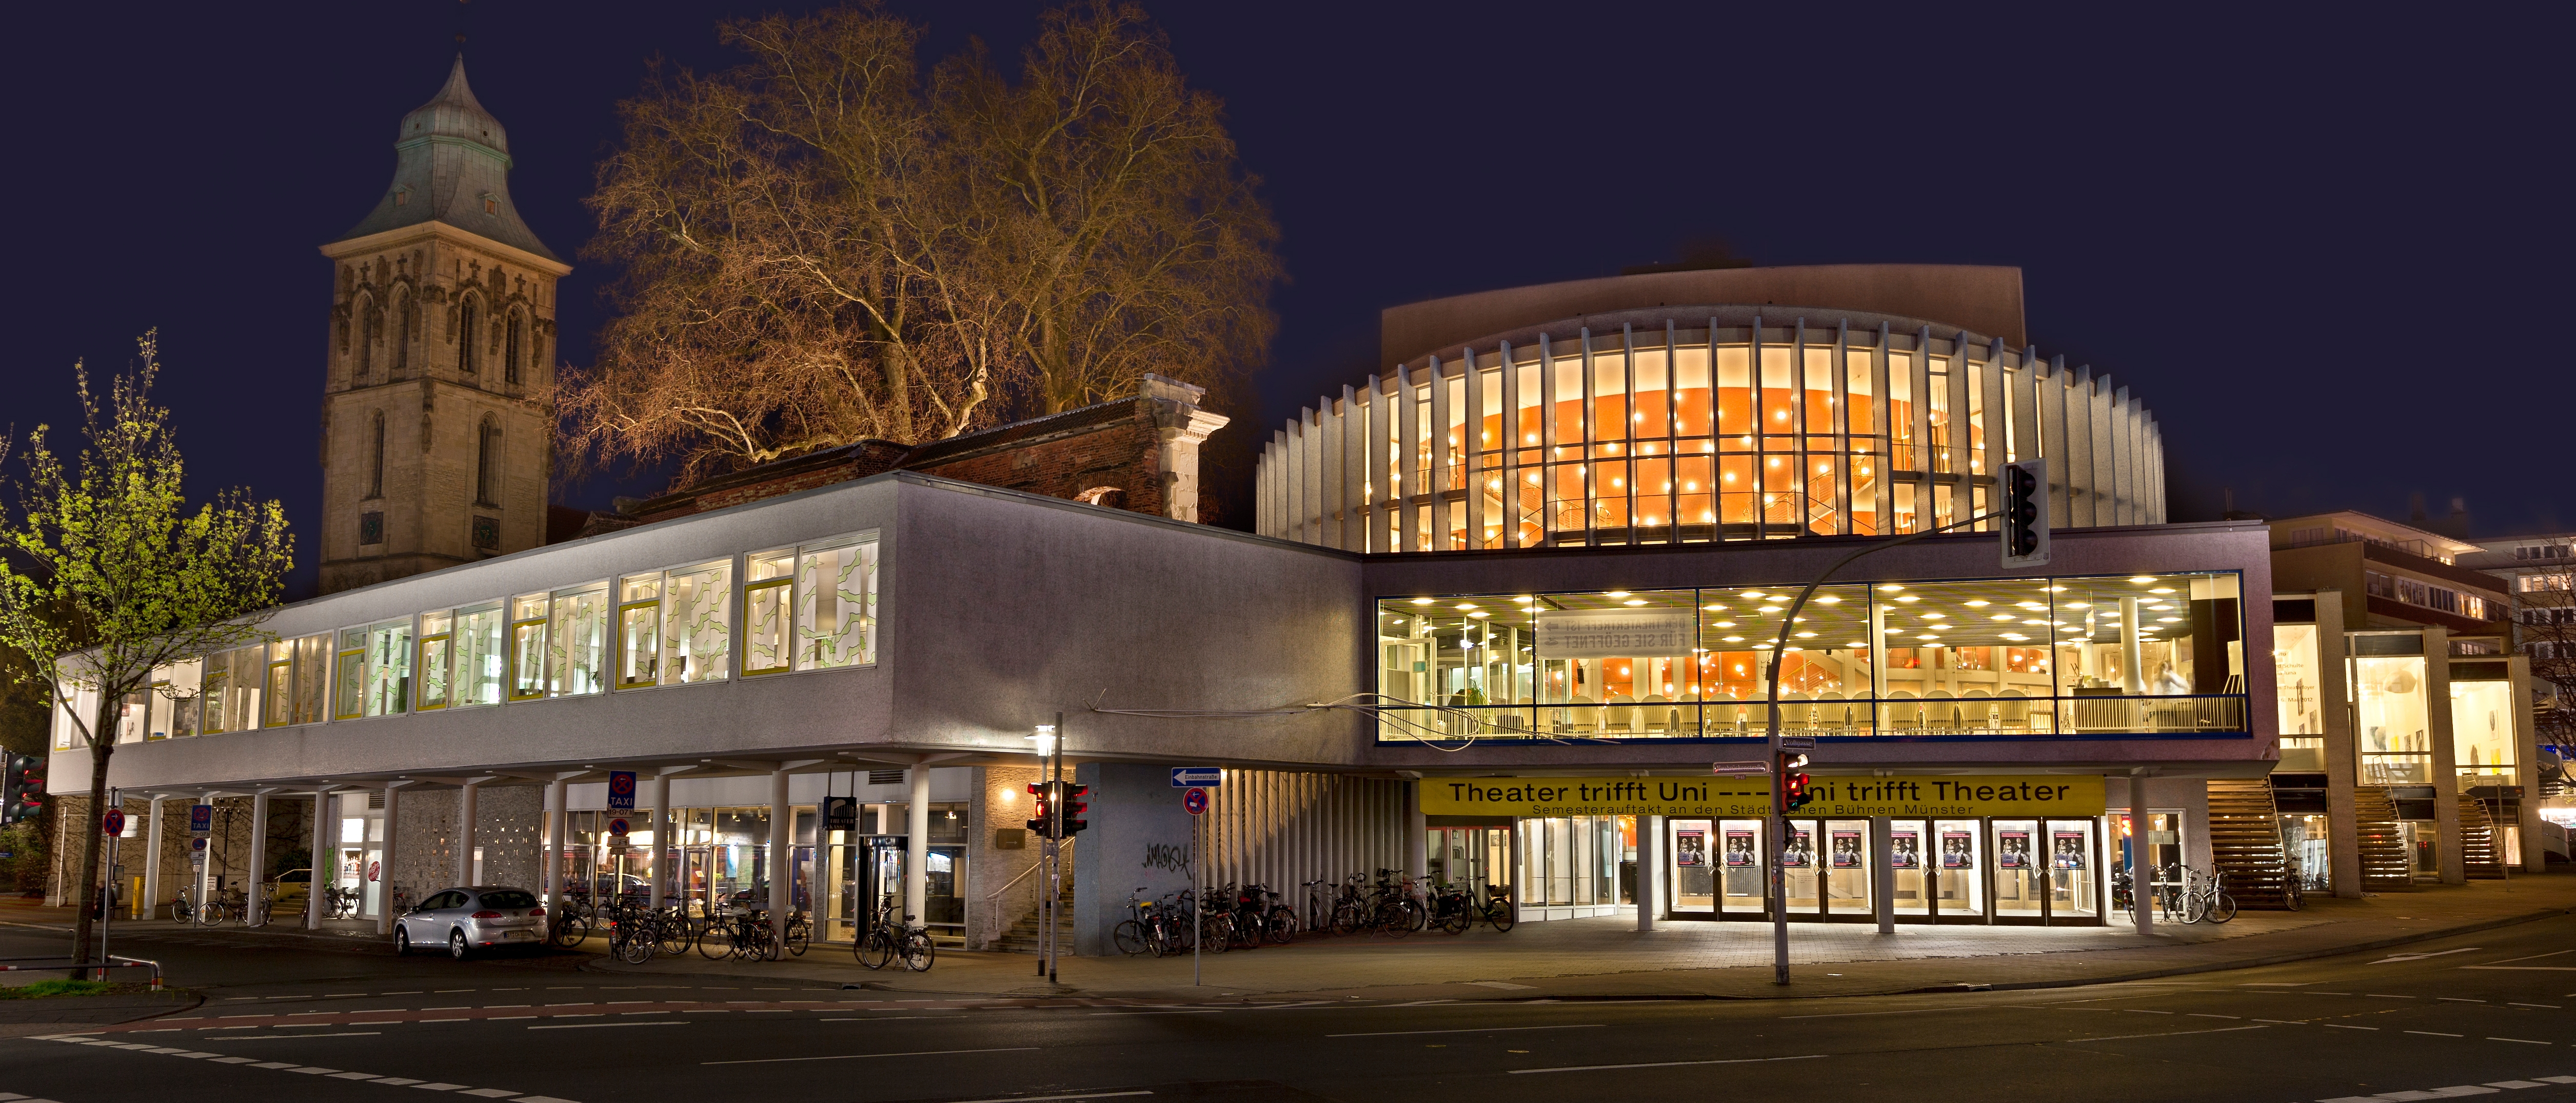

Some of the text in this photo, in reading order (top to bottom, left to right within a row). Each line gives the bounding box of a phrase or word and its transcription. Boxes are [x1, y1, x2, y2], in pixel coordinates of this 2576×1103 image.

[1448, 782, 1569, 802] Theater
[1578, 782, 1647, 802] trifft
[1659, 782, 1708, 802] Uni
[1800, 781, 1835, 801] ni
[1847, 781, 1920, 801] trifft
[1931, 781, 2070, 801] Theater
[610, 797, 633, 806] TAXI
[1533, 804, 1662, 815] Semesterauftakt
[1669, 806, 1687, 814] an
[1694, 804, 1723, 814] den
[1835, 804, 1896, 815] Bühnen
[1905, 804, 1974, 815] Münster
